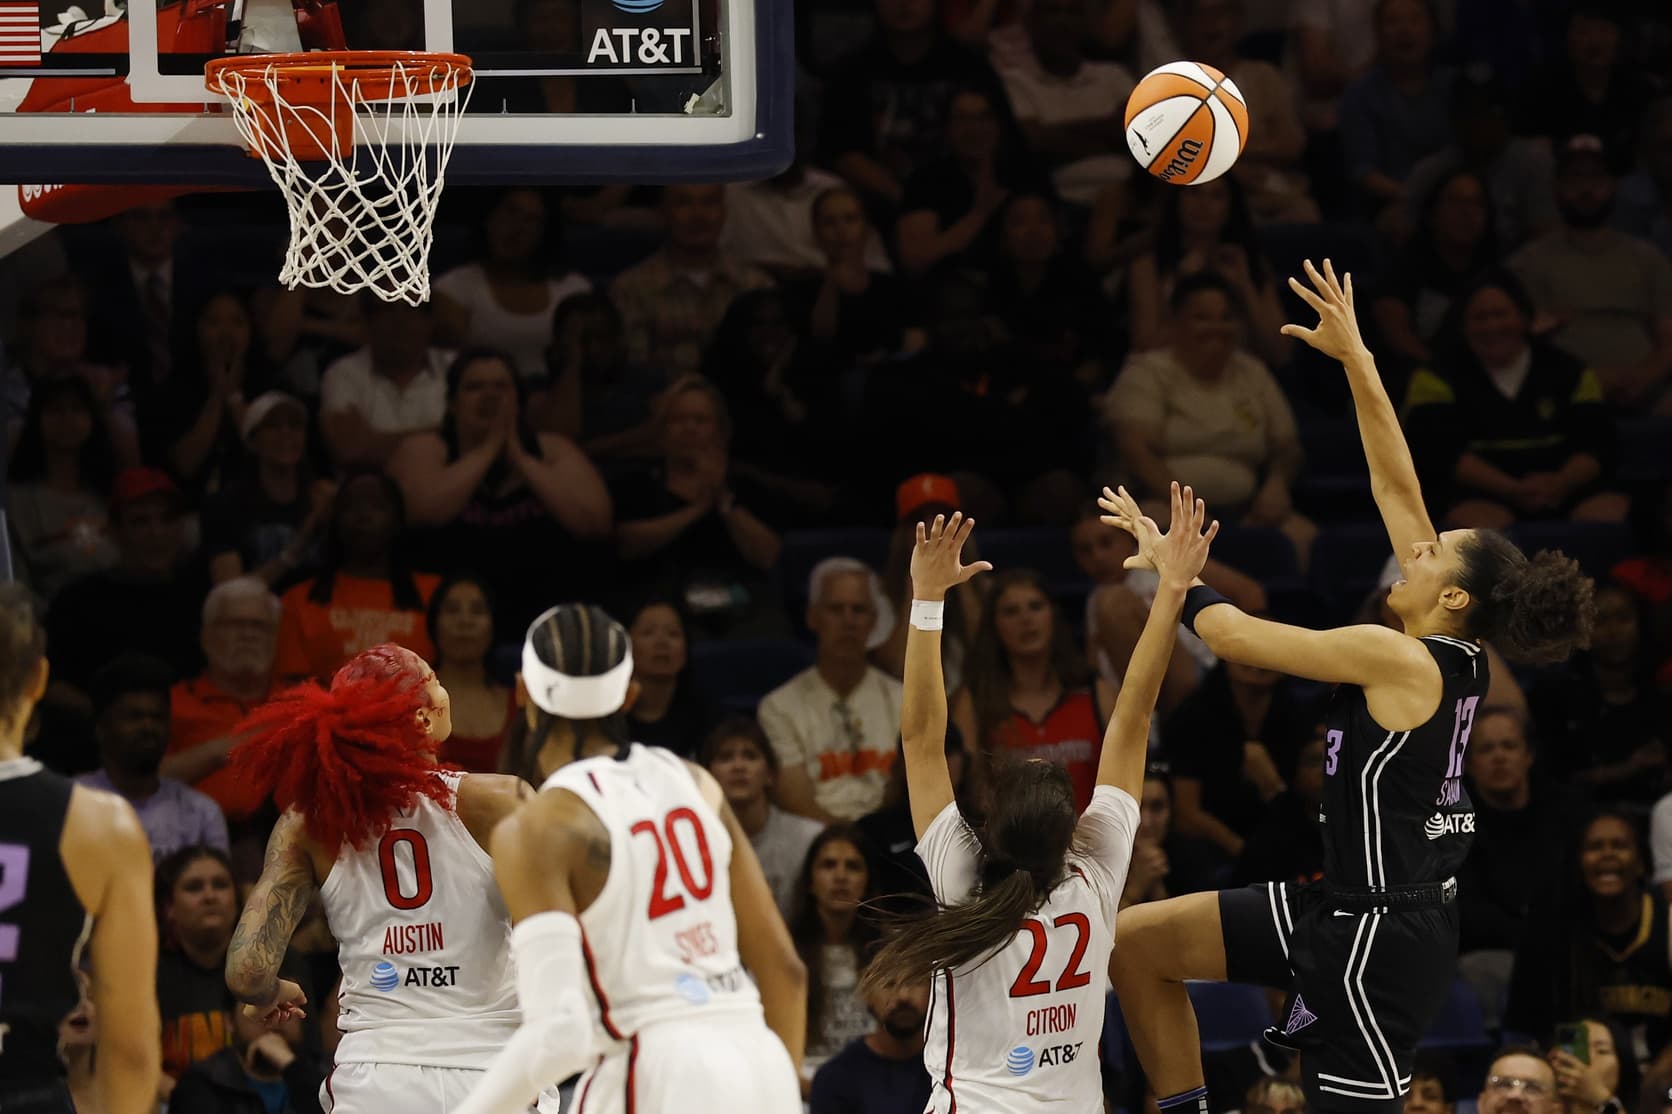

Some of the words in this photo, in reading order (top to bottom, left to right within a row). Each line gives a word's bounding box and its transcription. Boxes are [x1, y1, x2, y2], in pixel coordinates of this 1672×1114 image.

[586, 27, 691, 64] AT&T
[1443, 812, 1476, 835] AT&
[378, 828, 433, 910] 0
[630, 807, 714, 920] 20
[383, 922, 444, 955] AUSTIN
[1009, 912, 1091, 998] 22
[404, 966, 460, 988] AT&T
[1026, 1003, 1077, 1036] CITRON
